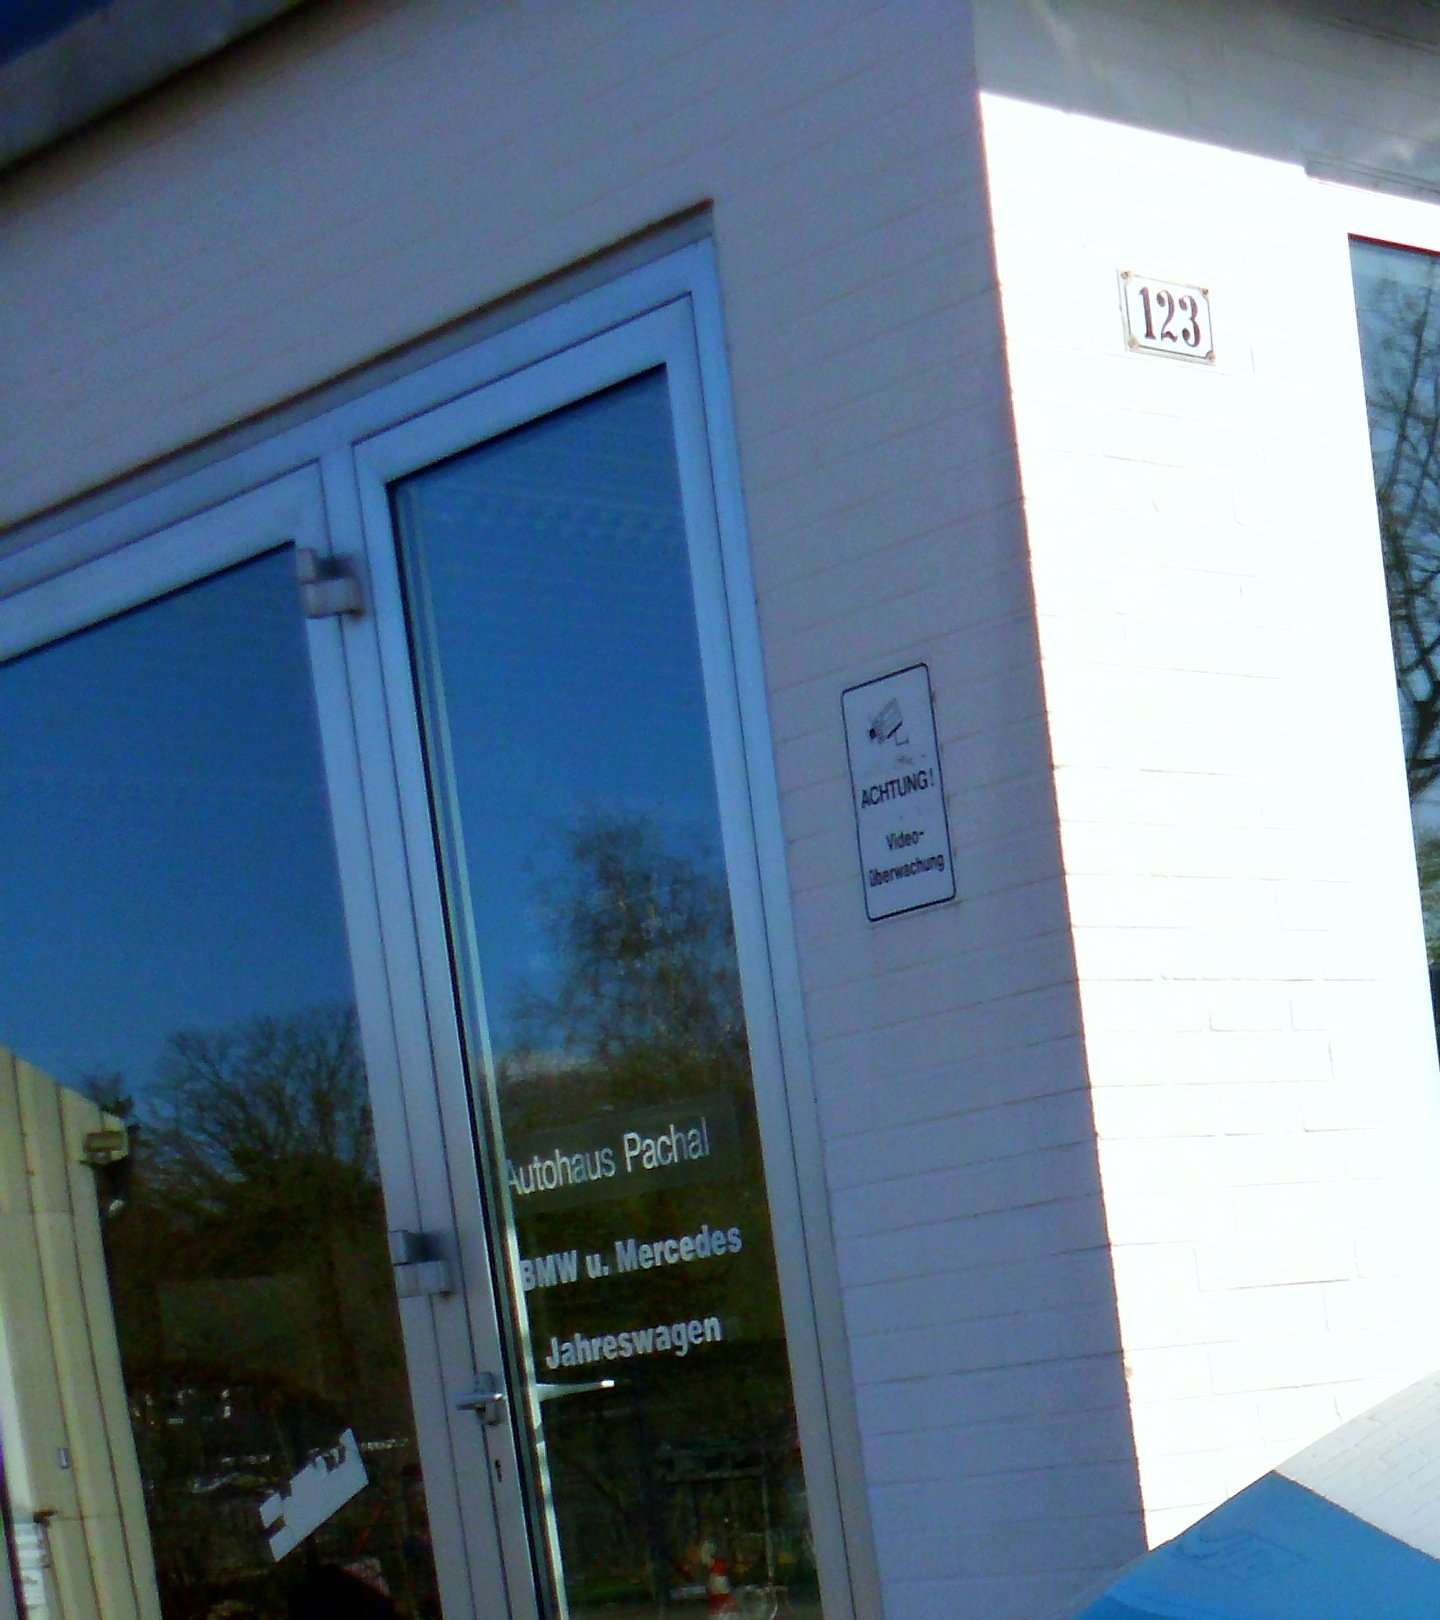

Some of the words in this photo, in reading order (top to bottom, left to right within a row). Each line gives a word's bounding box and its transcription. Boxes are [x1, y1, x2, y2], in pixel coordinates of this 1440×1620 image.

[1139, 286, 1201, 348] 123
[505, 1146, 616, 1197] Autohaus
[624, 1115, 711, 1174] Pachal
[519, 1250, 579, 1292] BMW
[585, 1252, 609, 1281] u.
[615, 1224, 744, 1274] Mercedes
[545, 1314, 722, 1370] Jahreswagen
